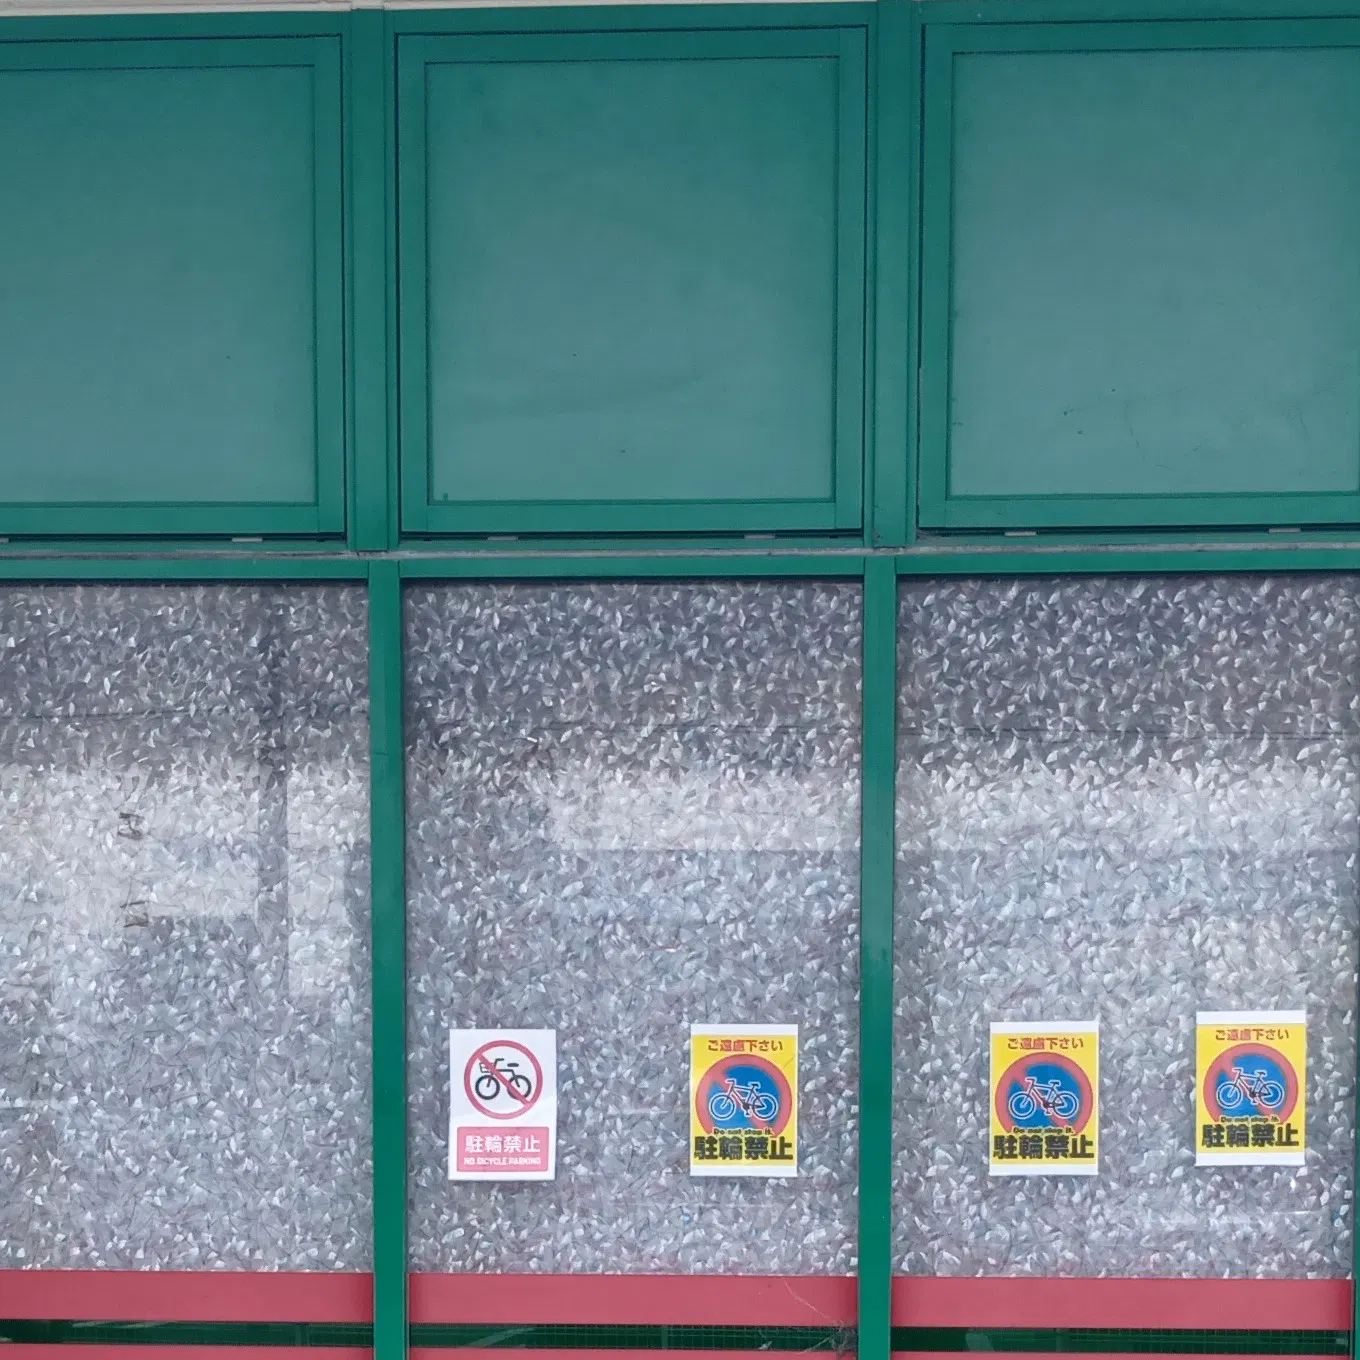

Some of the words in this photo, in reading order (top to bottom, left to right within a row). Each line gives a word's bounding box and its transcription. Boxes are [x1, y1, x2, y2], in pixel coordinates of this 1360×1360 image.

[1215, 1028, 1289, 1041] ご遠慮下さい
[708, 1039, 784, 1052] ご遠慮下さい
[1007, 1037, 1084, 1050] ご遠慮下さい
[1202, 1123, 1299, 1147] 駐輪禁止
[465, 1135, 540, 1153] 駐輪禁止
[694, 1136, 793, 1160] 駐輪禁止
[993, 1135, 1094, 1159] 駐輪禁止
[464, 1157, 475, 1165] NO
